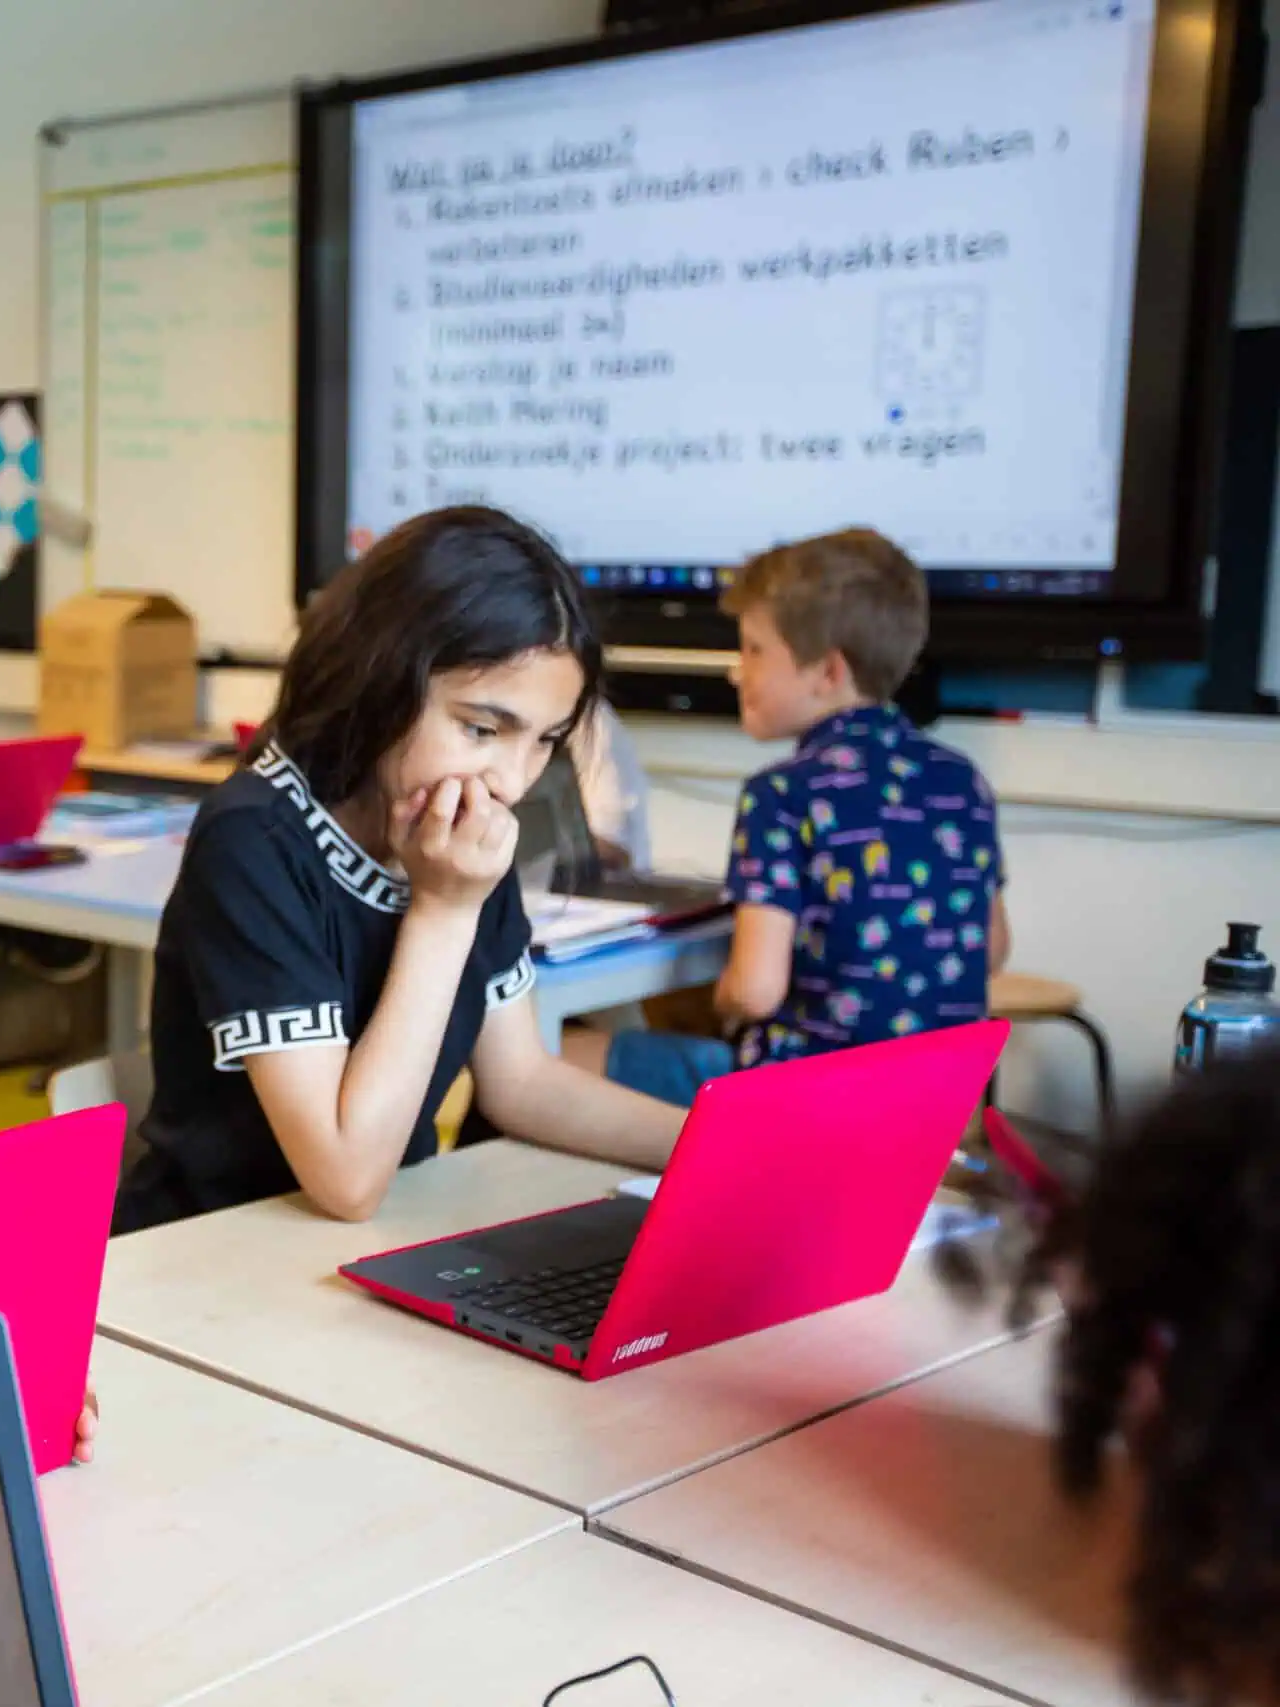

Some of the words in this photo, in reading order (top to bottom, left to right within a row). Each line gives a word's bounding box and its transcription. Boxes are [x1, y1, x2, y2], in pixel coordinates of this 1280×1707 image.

[786, 141, 887, 185] check
[908, 127, 1034, 170] Ruben
[738, 232, 1009, 281] werkpakketten
[759, 425, 843, 460] twee
[856, 424, 986, 469] vragen
